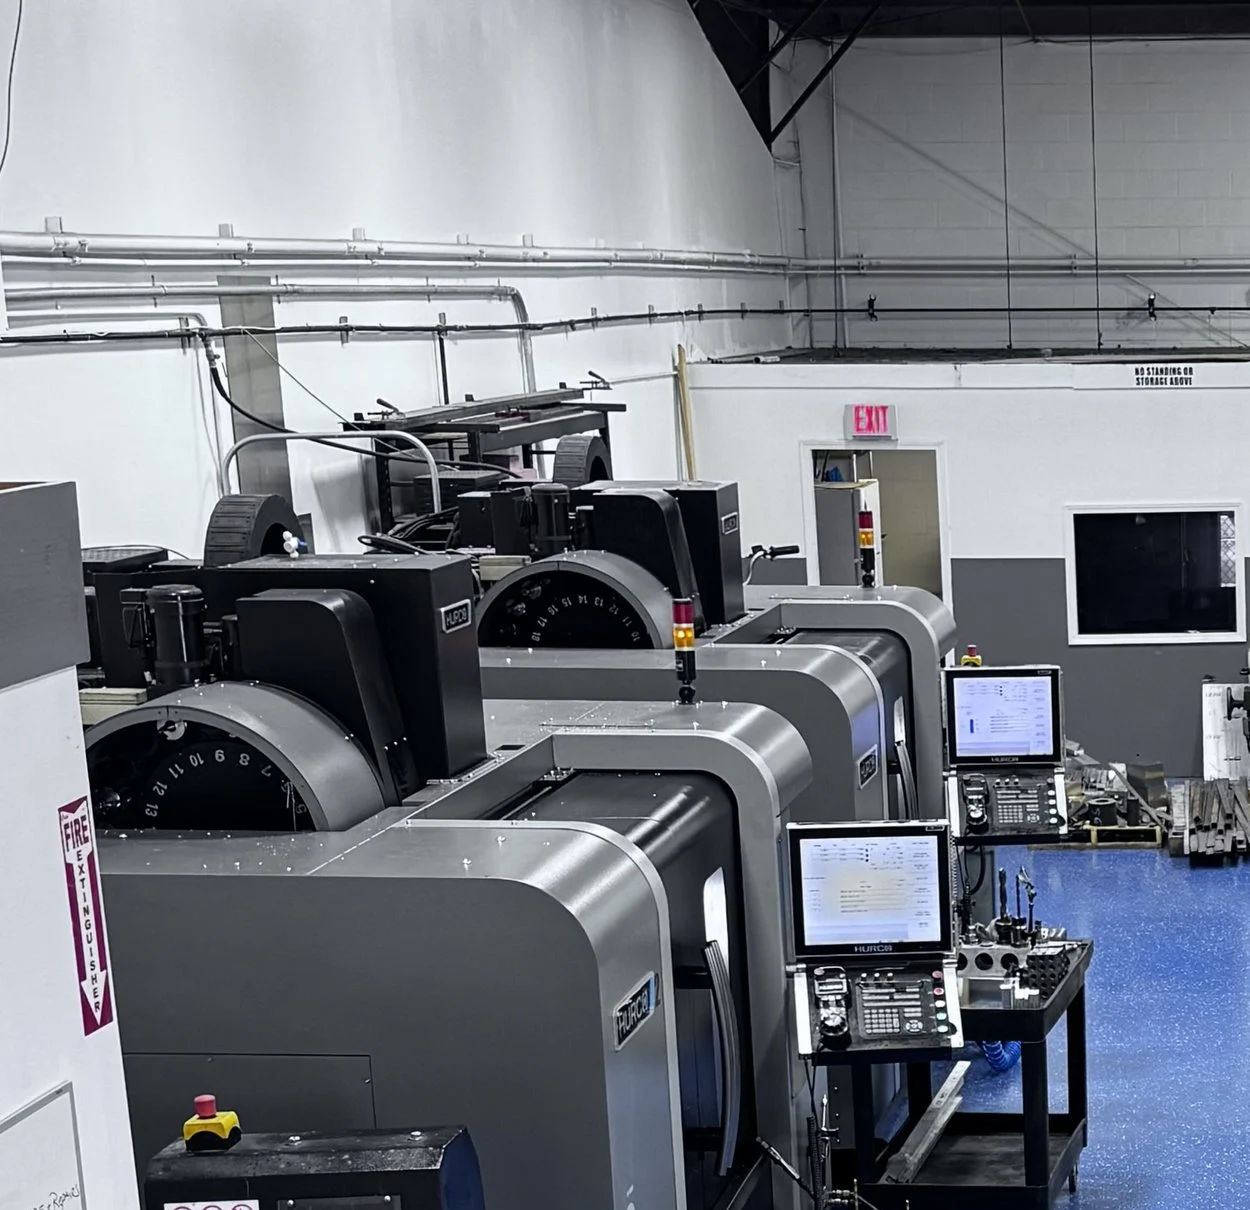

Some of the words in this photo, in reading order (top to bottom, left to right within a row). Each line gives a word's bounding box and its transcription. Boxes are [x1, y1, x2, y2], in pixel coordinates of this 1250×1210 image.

[1135, 367, 1145, 376] NO
[1146, 367, 1182, 376] STANDING
[1183, 367, 1194, 376] OR
[1136, 377, 1168, 386] STORAGE
[1169, 377, 1193, 386] ABOVE
[854, 405, 888, 432] EXIT
[189, 753, 204, 767] 10
[214, 749, 226, 762] 9
[239, 753, 250, 766] 8
[168, 763, 184, 778] 11
[261, 764, 272, 777] 7
[152, 781, 168, 796] 12
[145, 803, 158, 817] 13
[63, 815, 90, 852] FIRE
[77, 850, 101, 1013] EXTINGUISHER
[854, 945, 893, 953] HURCO
